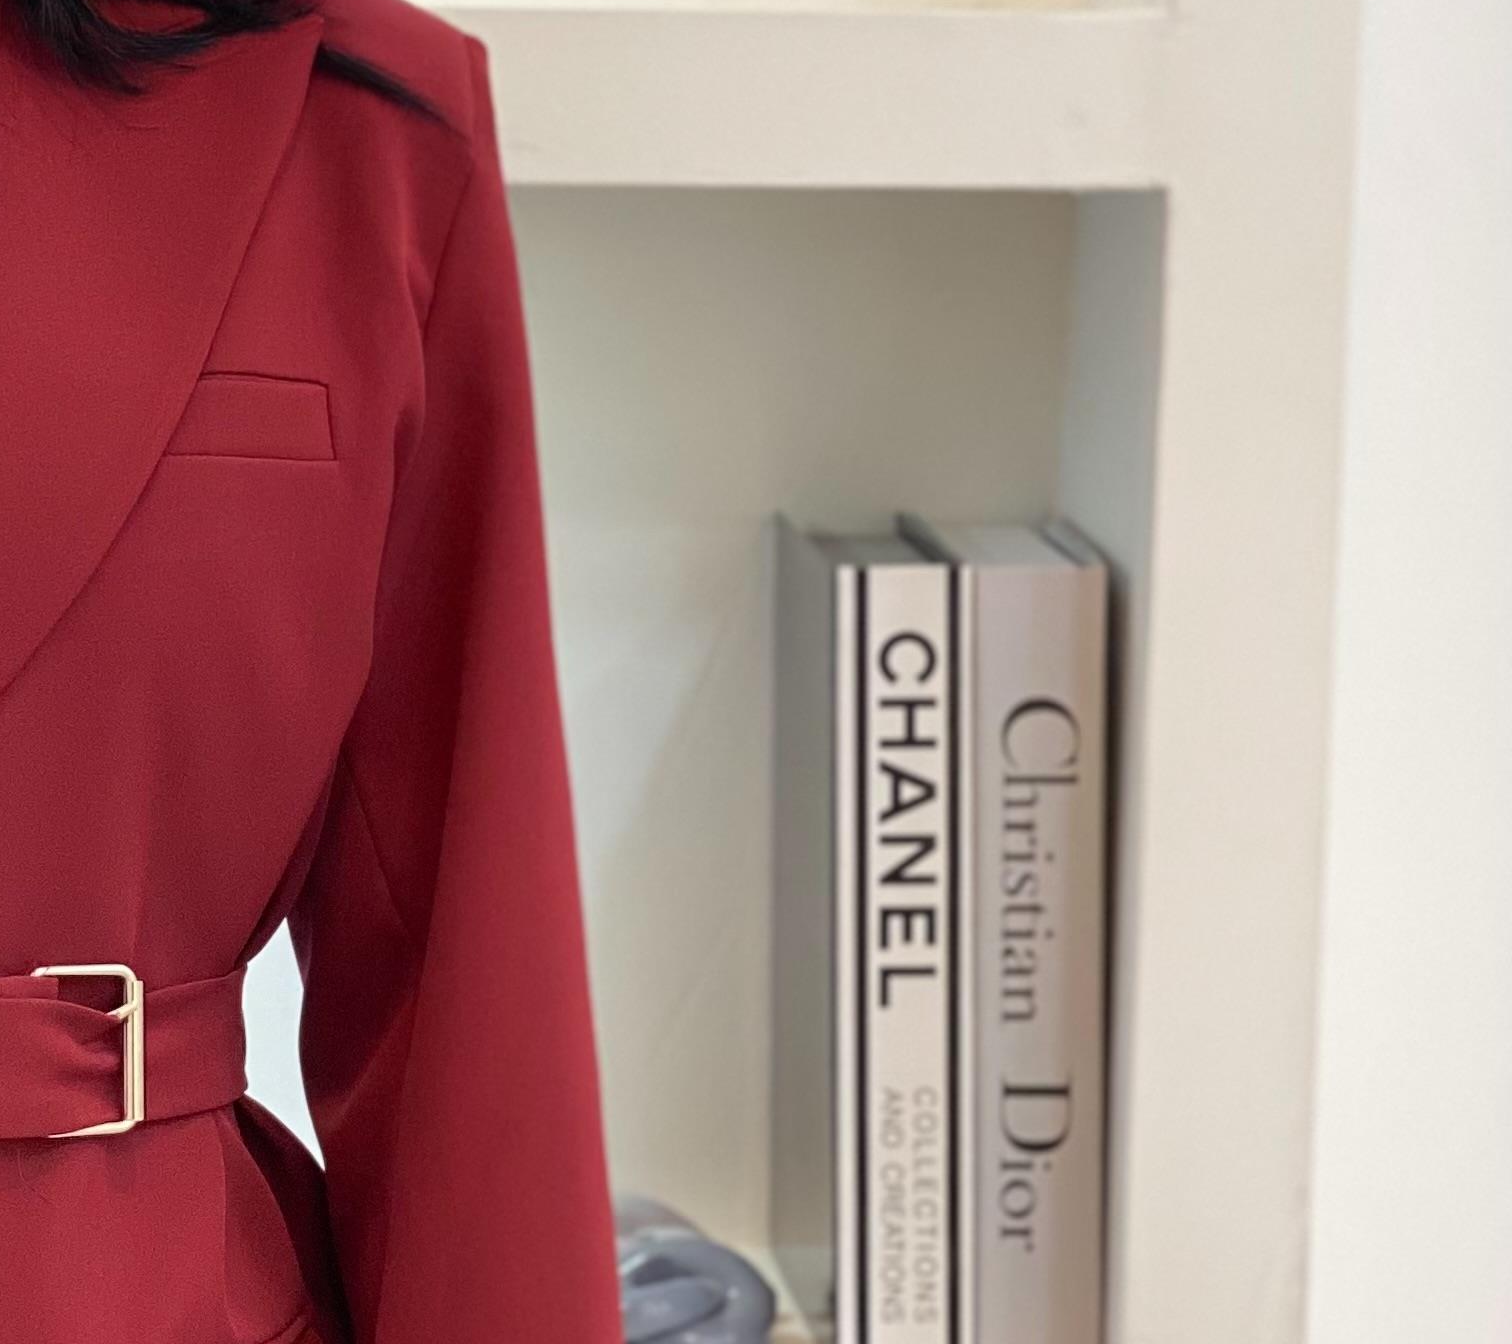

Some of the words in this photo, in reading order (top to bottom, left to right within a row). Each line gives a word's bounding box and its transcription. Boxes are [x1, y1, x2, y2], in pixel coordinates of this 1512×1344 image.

[879, 631, 937, 1008] CHANEL
[1001, 697, 1080, 1025] Christian
[879, 1086, 907, 1150] AND
[912, 1085, 939, 1325] COLLECTIONS
[999, 1073, 1073, 1253] Dior
[879, 1162, 907, 1325] CREATIONS
